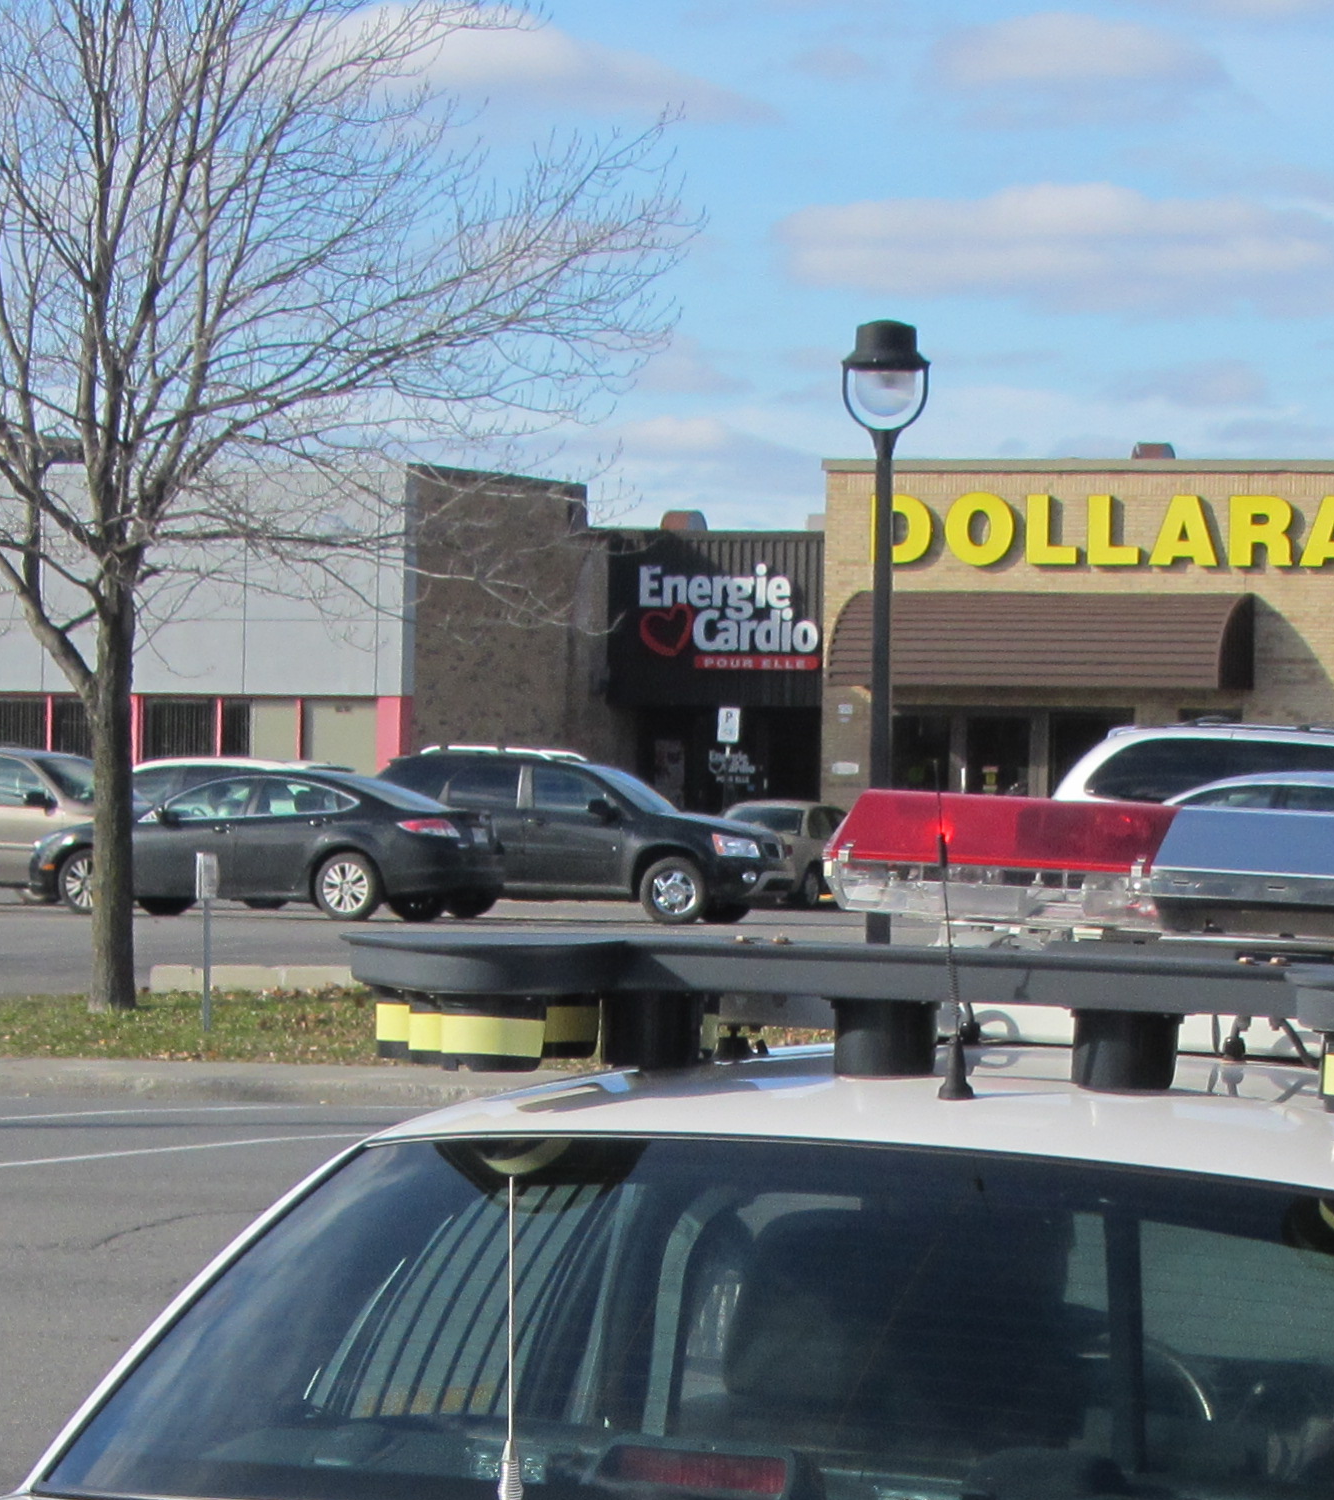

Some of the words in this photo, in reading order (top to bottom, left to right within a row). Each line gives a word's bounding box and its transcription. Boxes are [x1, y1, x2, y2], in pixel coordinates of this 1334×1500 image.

[639, 563, 792, 620] Energie
[693, 607, 819, 653] Cardio
[704, 659, 755, 669] POUR
[763, 660, 807, 670] ELLE
